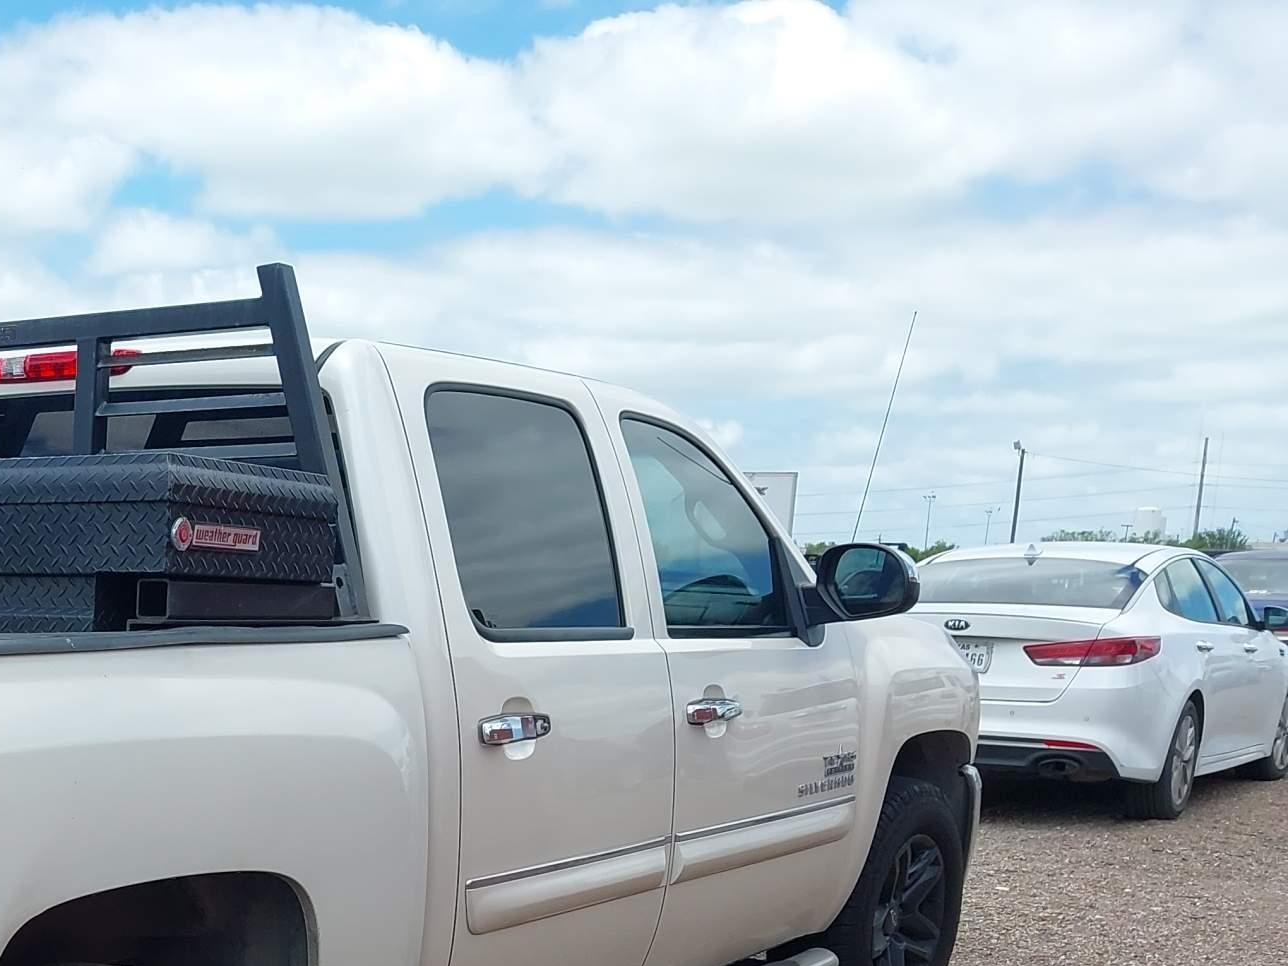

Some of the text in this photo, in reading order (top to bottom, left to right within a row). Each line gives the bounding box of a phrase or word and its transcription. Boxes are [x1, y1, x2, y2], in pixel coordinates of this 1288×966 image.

[196, 527, 258, 546] weather guard
[947, 620, 966, 629] KIA
[797, 774, 854, 798] SILVERADO
